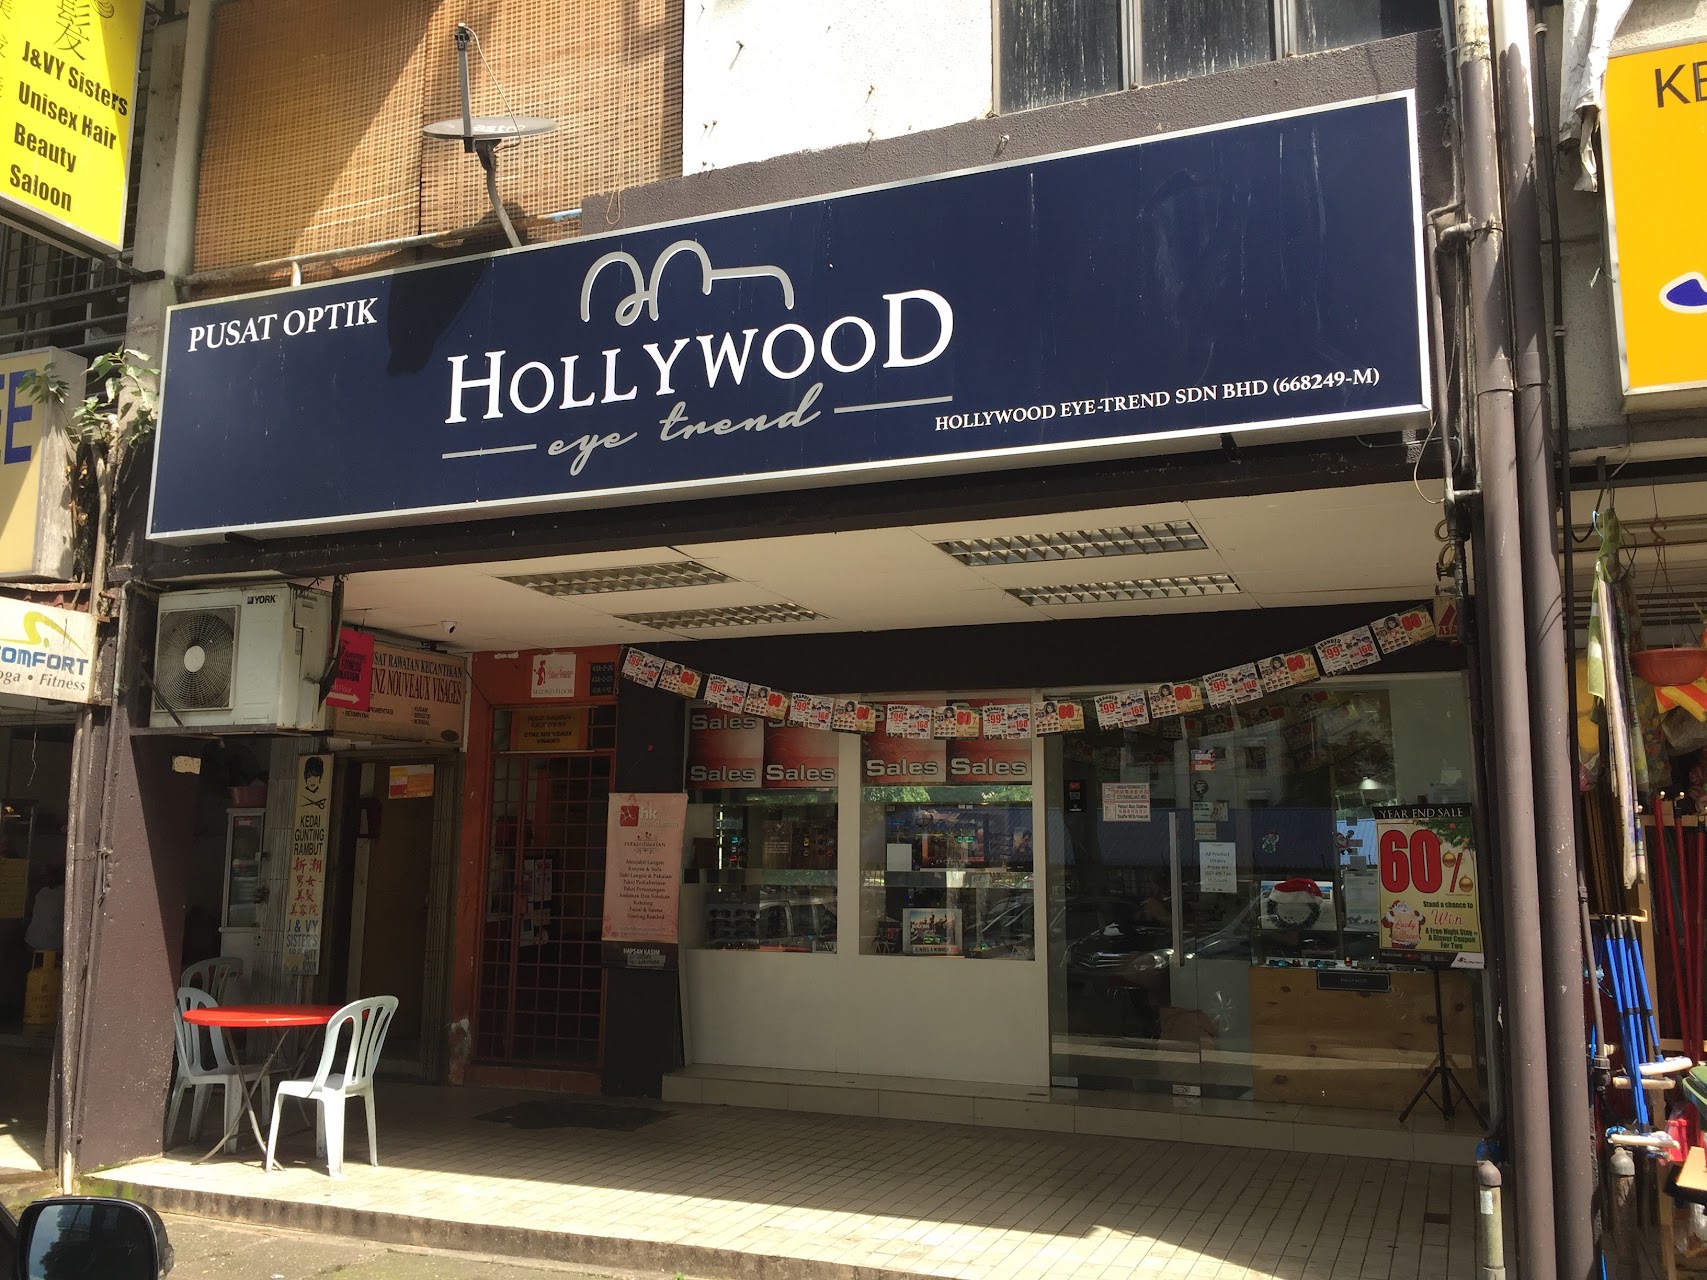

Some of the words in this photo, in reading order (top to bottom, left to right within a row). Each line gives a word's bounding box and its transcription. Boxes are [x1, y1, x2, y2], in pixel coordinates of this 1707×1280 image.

[22, 40, 66, 81] J&VY
[68, 66, 129, 116] Sisters
[18, 80, 78, 132] Unisex
[82, 114, 118, 150] Hair
[14, 121, 77, 173] Beauty
[10, 164, 72, 213] Saloon
[188, 313, 278, 353] PUSAT
[283, 297, 379, 336] OPTIK
[935, 403, 1057, 432] HOLLYWOOD
[1060, 391, 1171, 418] EYE-TREND
[1175, 386, 1218, 404] SDN
[1222, 379, 1269, 400] BHD
[1273, 366, 1381, 397] (668249-M)
[548, 430, 638, 477] eye
[660, 382, 824, 443] trend
[254, 594, 276, 605] YORK
[1358, 643, 1374, 656] 168
[0, 646, 89, 676] OMFORT
[421, 659, 463, 679] KECANTIKAN
[0, 670, 21, 686] oga
[39, 673, 86, 691] Fitness
[387, 669, 431, 700] NOUVEAUX
[433, 677, 462, 705] VISAGES
[1242, 679, 1257, 691] 168
[817, 712, 830, 720] 168
[1130, 704, 1145, 715] 168
[691, 713, 758, 731] Sales
[916, 720, 929, 729] 168
[1015, 719, 1029, 728] 168
[690, 765, 757, 782] Sales
[765, 764, 836, 782] Sales
[866, 758, 939, 777] Sales
[950, 756, 1028, 776] Sales
[300, 815, 321, 828] KEDAI
[1379, 808, 1409, 819] YEAR
[1412, 808, 1436, 818] END
[1437, 807, 1464, 818] SALE
[294, 828, 325, 842] GUNTING
[293, 842, 323, 856] RAMBUT
[1379, 828, 1475, 893] 60%
[1423, 900, 1440, 909] Stand
[1445, 901, 1466, 909] chance
[294, 919, 302, 933] &
[305, 919, 319, 933] VY
[1395, 919, 1416, 931] Lucky
[1430, 908, 1466, 927] Win
[1430, 927, 1444, 936] Free
[1444, 928, 1460, 936] Night
[1460, 928, 1473, 937] Stay
[1434, 935, 1454, 943] Dinner
[1453, 936, 1476, 944] Coupon
[1440, 941, 1450, 949] For
[1450, 942, 1464, 950] Two
